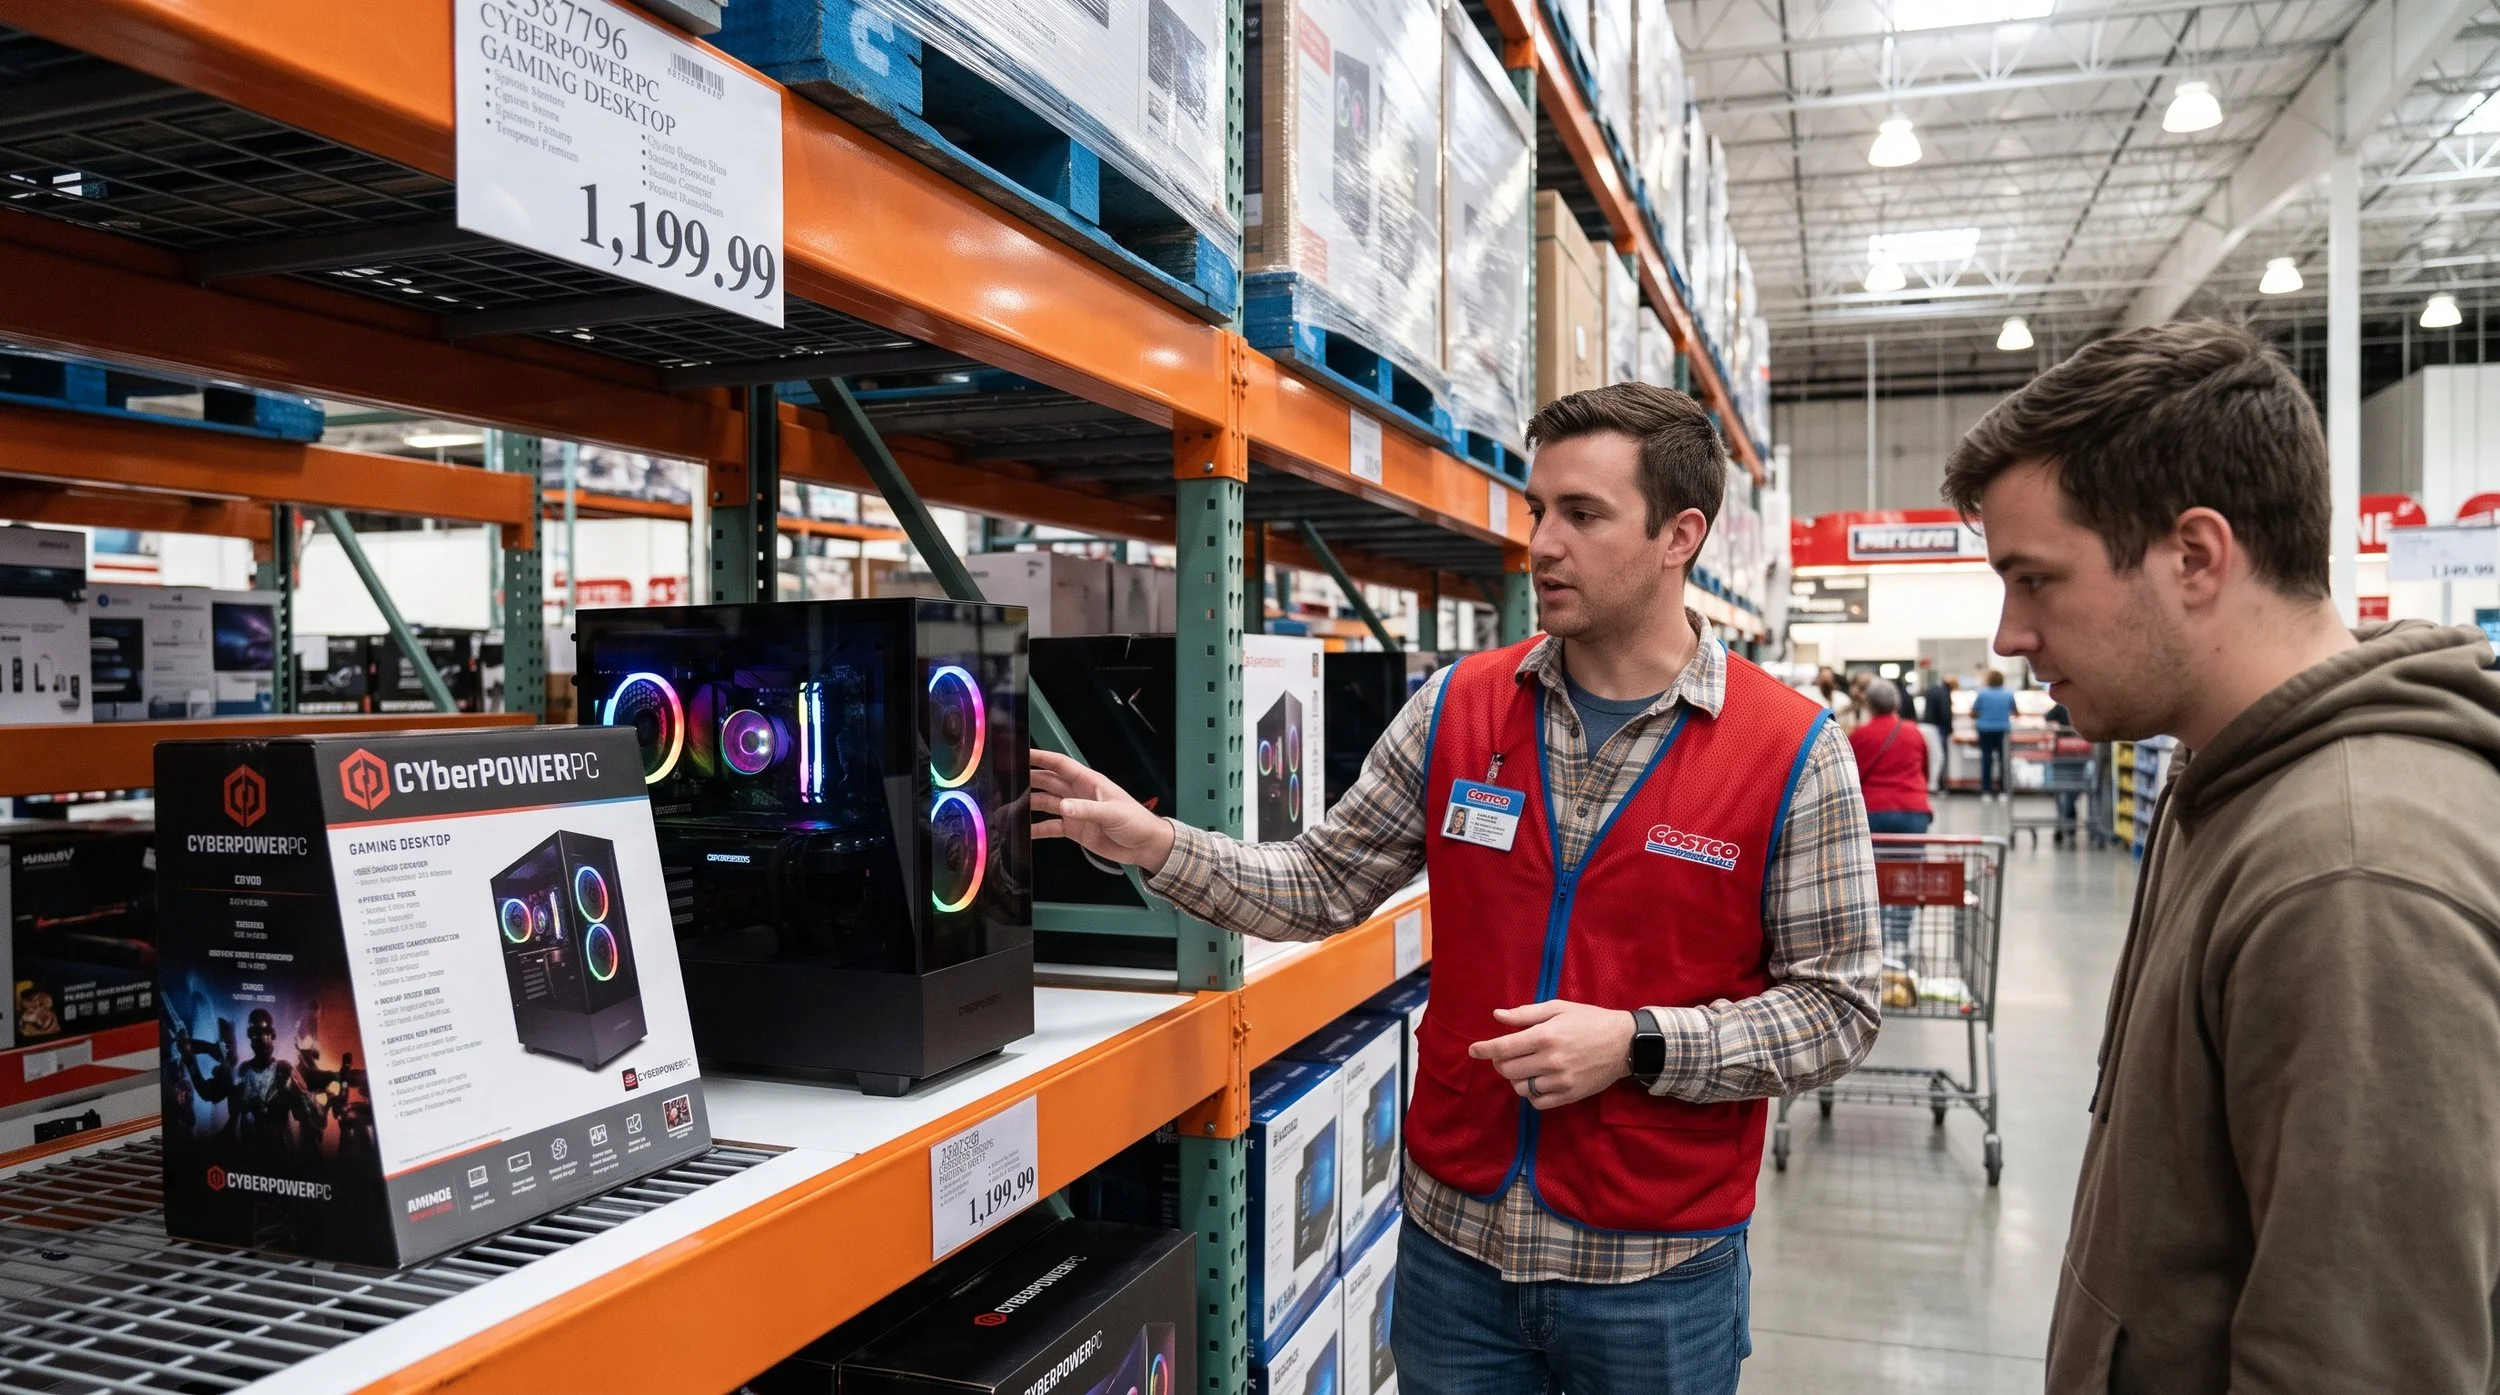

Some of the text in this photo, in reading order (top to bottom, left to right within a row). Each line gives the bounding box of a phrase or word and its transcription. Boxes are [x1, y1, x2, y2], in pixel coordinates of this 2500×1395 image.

[480, 3, 660, 102] CYBERPOWERPC
[480, 34, 676, 136] GAMING DESKTOP
[580, 183, 776, 300] 1,199.99
[187, 834, 308, 856] CYBERPOWERPC
[349, 833, 451, 856] GAMING DESKTOP
[1647, 823, 1741, 861] COSTCO
[227, 1172, 332, 1201] CYBERPOWERPC
[968, 1166, 1035, 1228] 1,199.99
